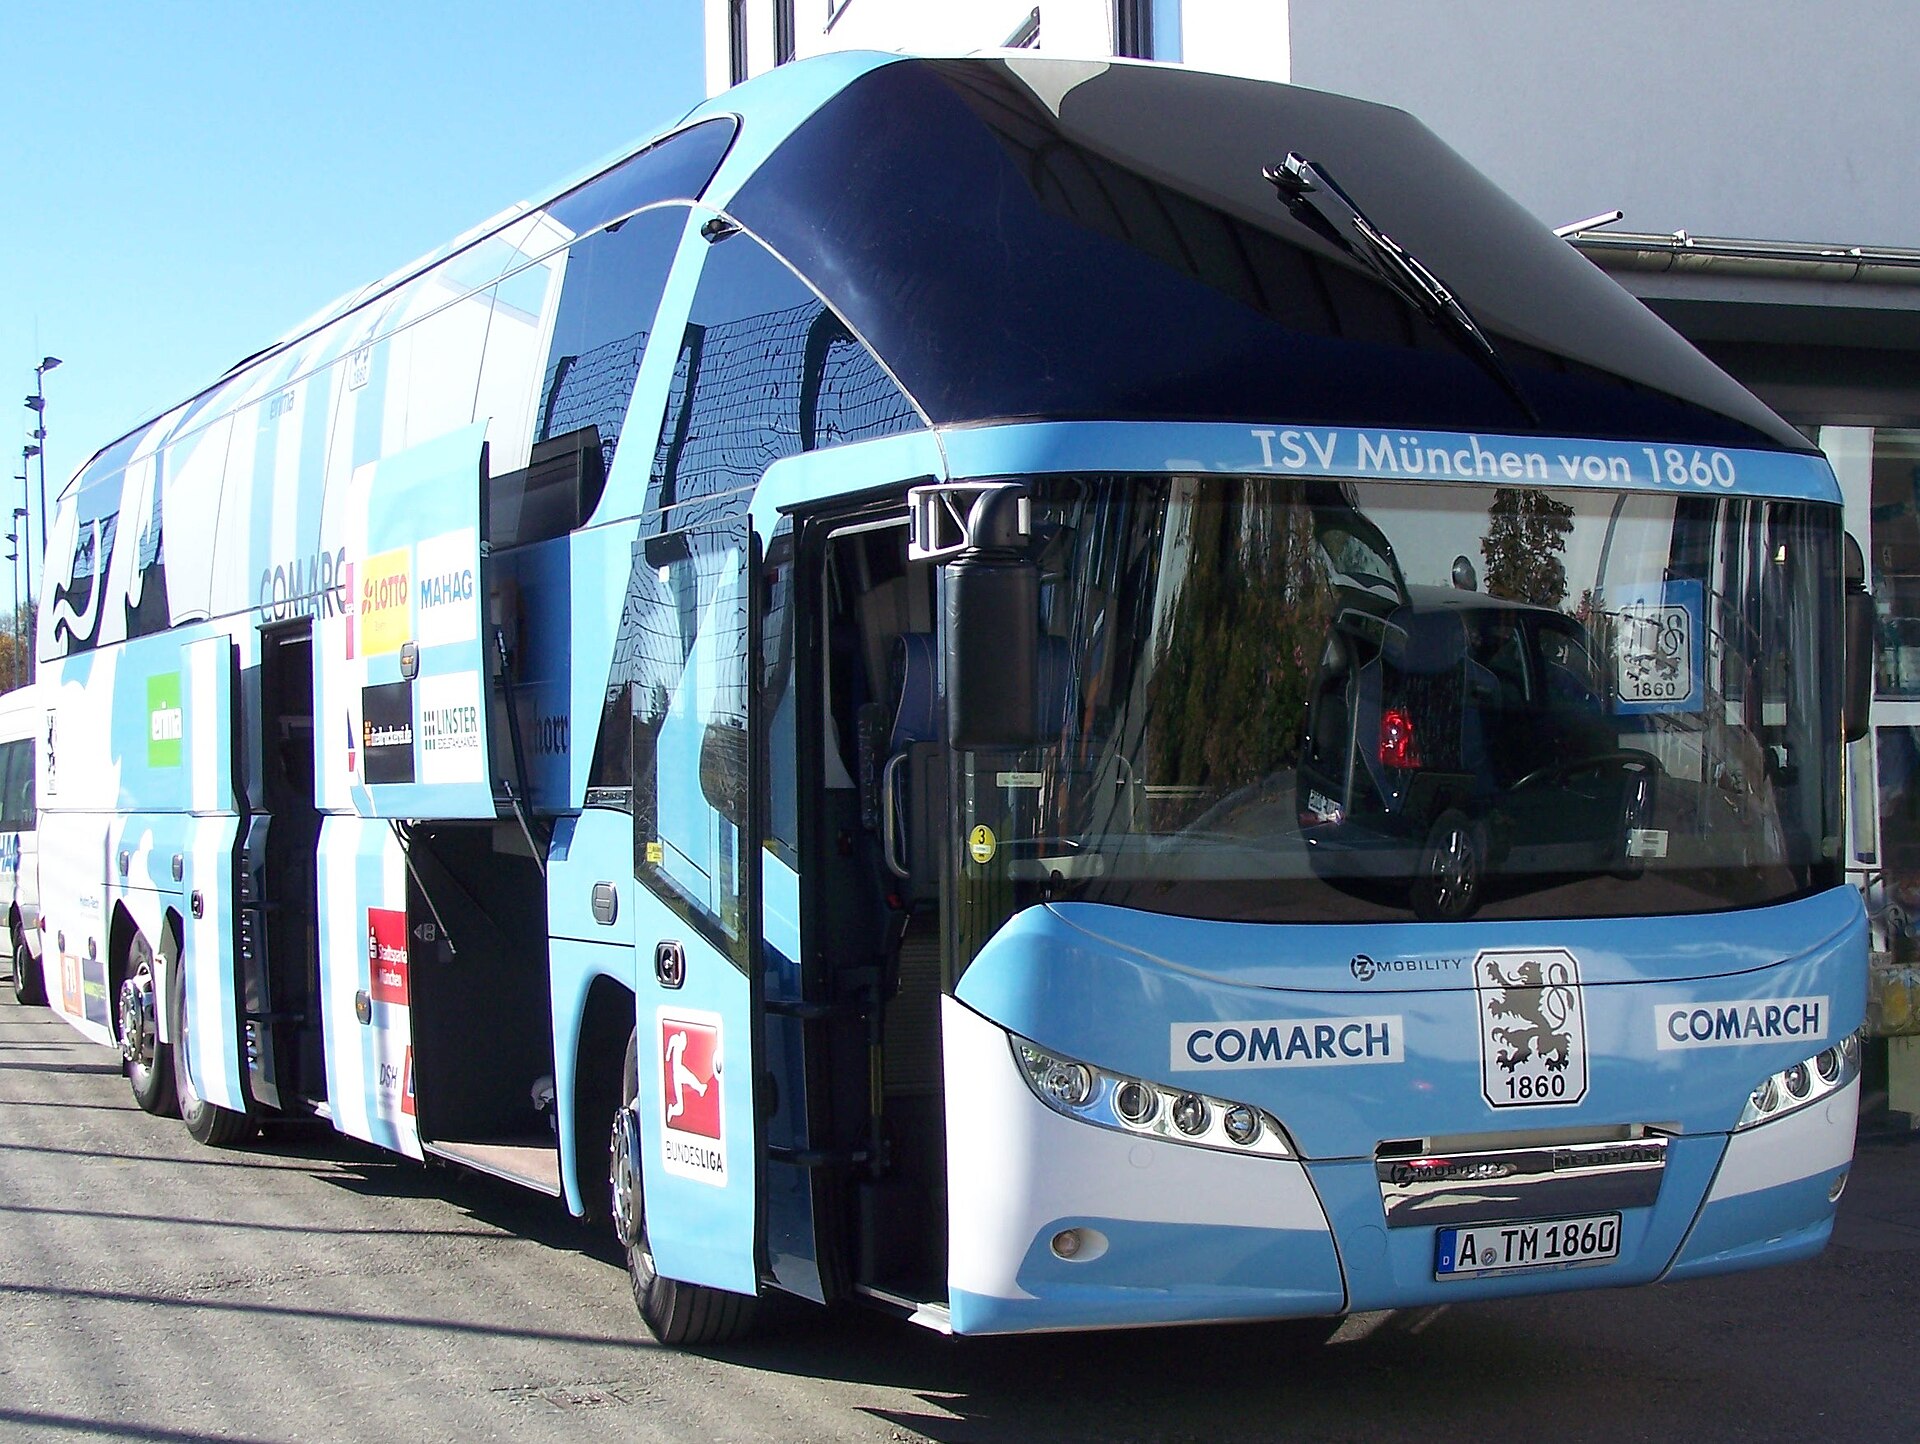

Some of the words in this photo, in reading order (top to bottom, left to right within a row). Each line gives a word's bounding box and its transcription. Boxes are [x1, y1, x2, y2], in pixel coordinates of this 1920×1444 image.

[1251, 430, 1337, 469] TSV
[1358, 434, 1548, 480] München
[1559, 454, 1631, 482] von
[1643, 447, 1736, 489] 1860
[375, 573, 408, 611] LOTTO
[421, 569, 473, 609] MAHAG
[1632, 682, 1676, 697] 1860
[437, 706, 478, 735] LINSTER
[978, 828, 985, 844] 3
[1377, 959, 1462, 972] MOBILITY
[1667, 1003, 1821, 1042] COMARCH
[1186, 1022, 1391, 1065] COMARCH
[379, 1063, 398, 1089] DSH
[1505, 1074, 1566, 1099] 1860
[666, 1140, 723, 1173] BUNDESLIGA
[1555, 1147, 1660, 1167] NEOPLAN
[1459, 1233, 1477, 1267] A
[1501, 1228, 1539, 1263] TM
[1544, 1220, 1615, 1259] 1860
[1442, 1255, 1449, 1265] D
